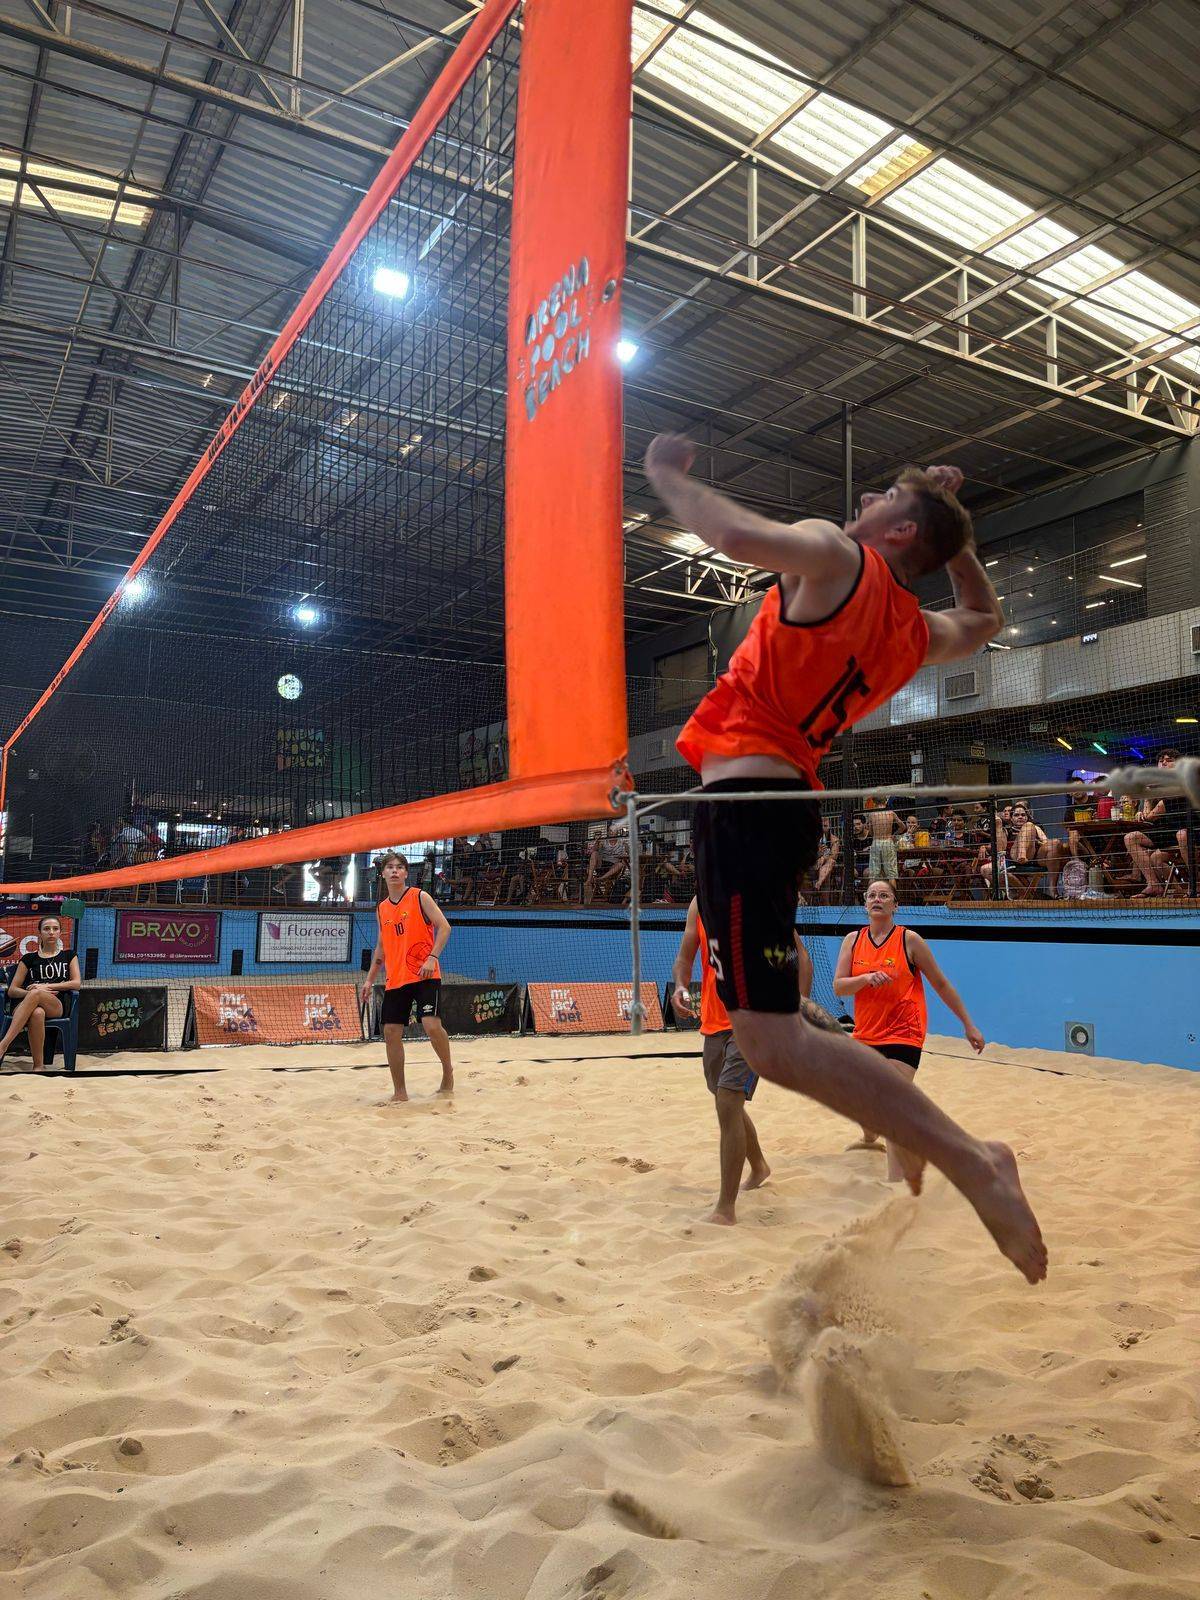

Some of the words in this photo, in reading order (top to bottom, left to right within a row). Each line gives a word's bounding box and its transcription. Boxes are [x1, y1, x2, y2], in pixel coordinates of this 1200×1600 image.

[525, 256, 590, 345] ARENA
[531, 299, 583, 378] POOL
[798, 655, 871, 748] 15
[131, 922, 201, 940] BRAVO
[287, 924, 346, 937] florence
[394, 922, 405, 936] 10
[39, 962, 68, 979] LOVE
[97, 997, 139, 1012] ARENA
[473, 990, 504, 1003] ARENA
[303, 1002, 337, 1026] jack
[477, 1000, 502, 1011] POOL
[550, 997, 578, 1017] jack
[100, 1008, 135, 1023] POOL
[216, 1003, 253, 1026] jack
[474, 1007, 506, 1023] BEACH
[97, 1018, 141, 1037] BEACH
